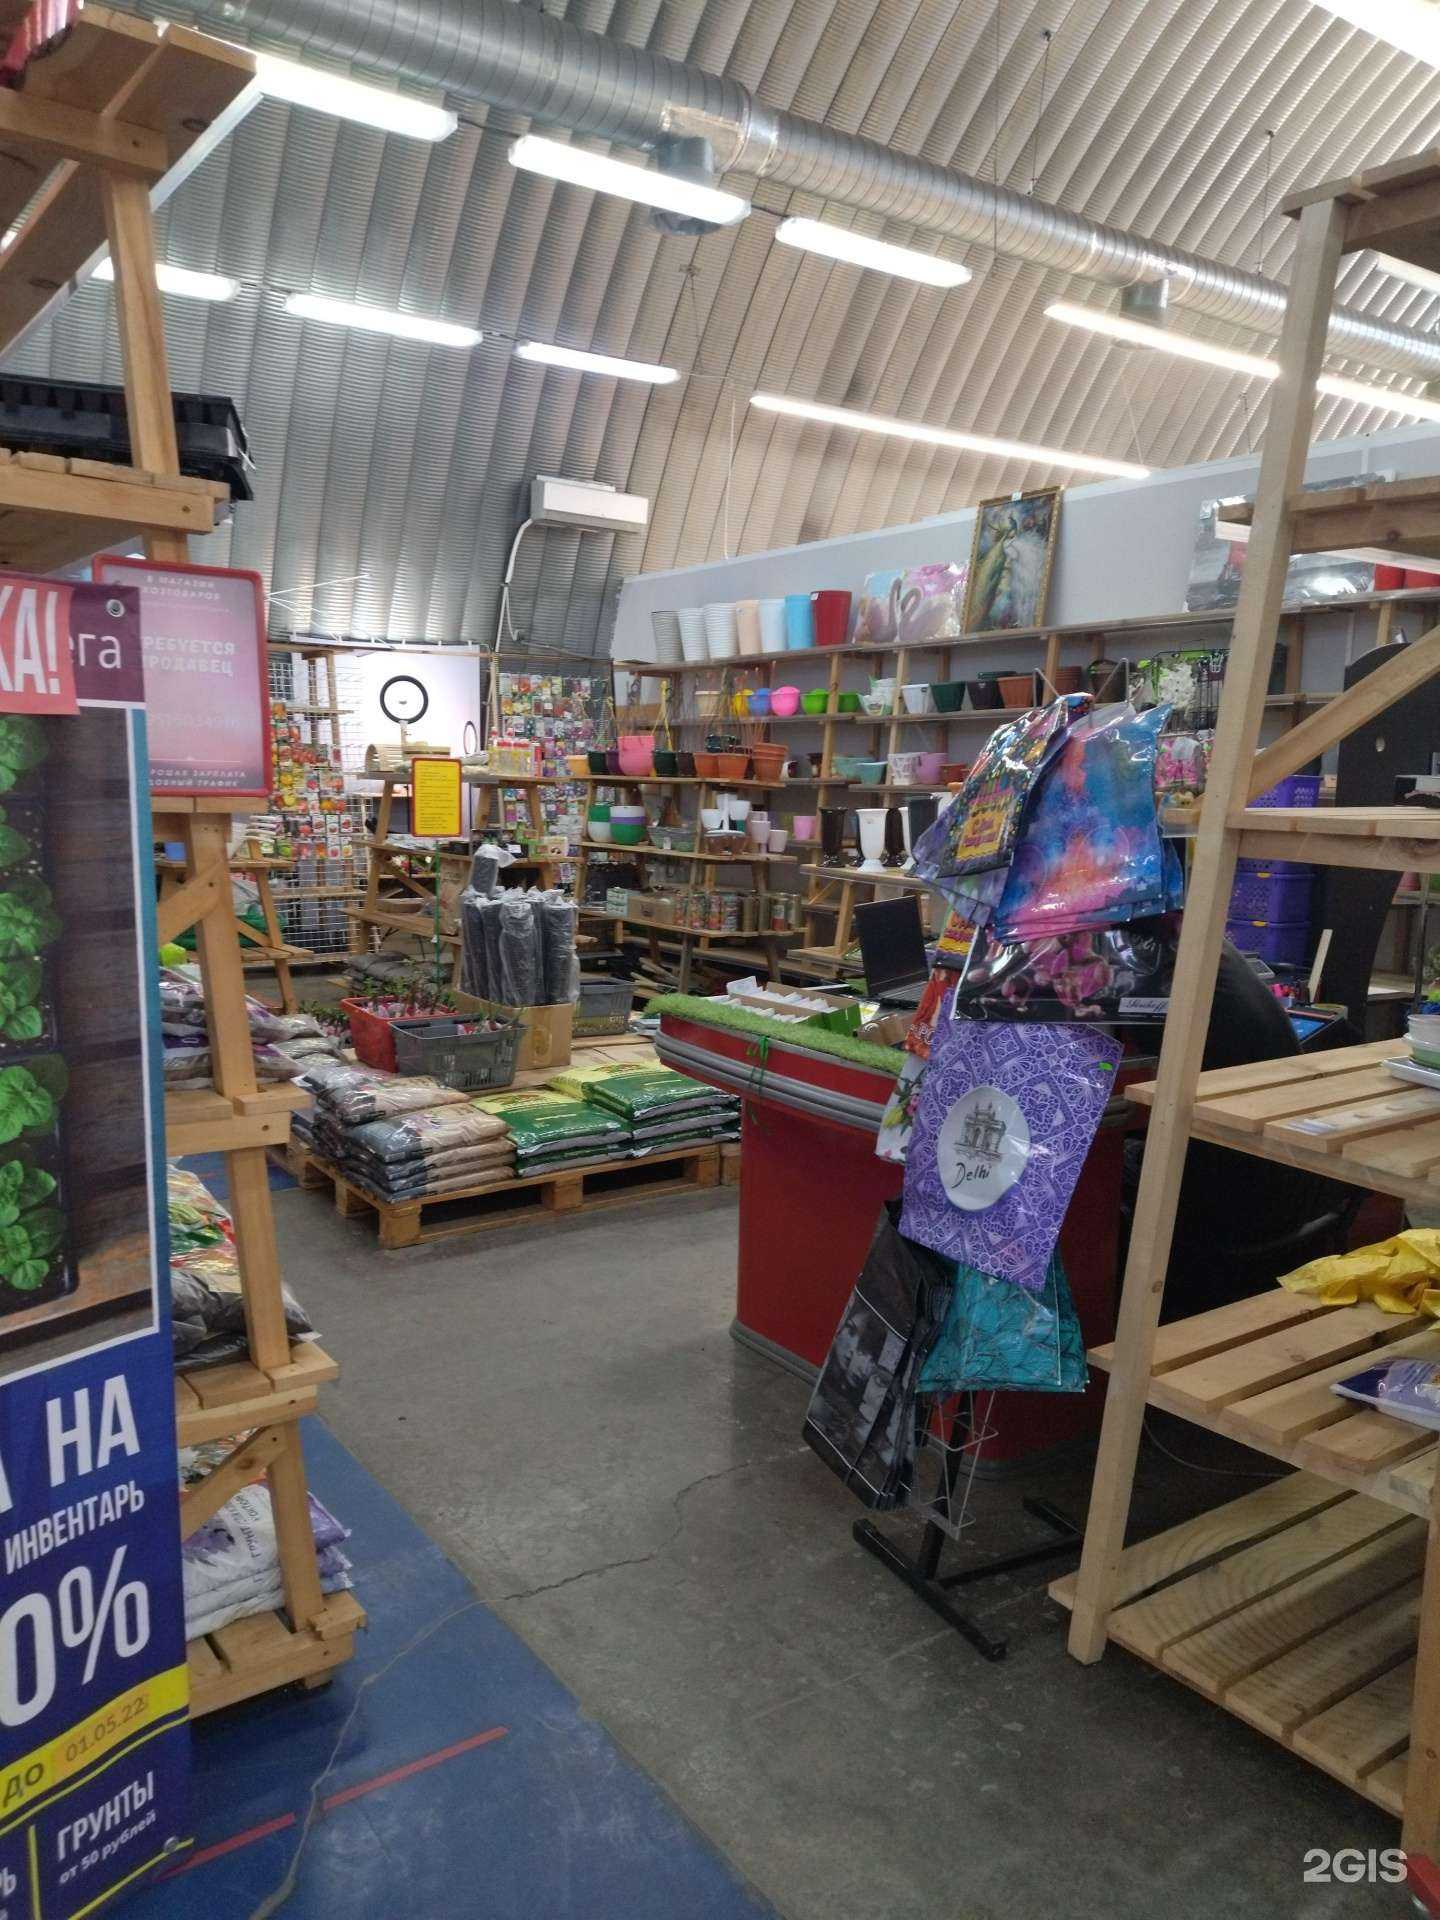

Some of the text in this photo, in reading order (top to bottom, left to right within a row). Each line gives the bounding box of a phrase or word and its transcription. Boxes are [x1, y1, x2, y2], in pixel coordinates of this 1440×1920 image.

[69, 633, 121, 669] га
[142, 636, 236, 655] РЕБУЕТСЯ
[951, 1162, 992, 1189] Delhi
[46, 1374, 140, 1488] НА
[4, 1480, 145, 1575] ИНВЕНТАРЬ
[3, 1696, 147, 1807] ДО 01.05.22
[57, 1770, 154, 1862] ГРУНТЫ
[59, 1808, 157, 1885] от 50 рублей
